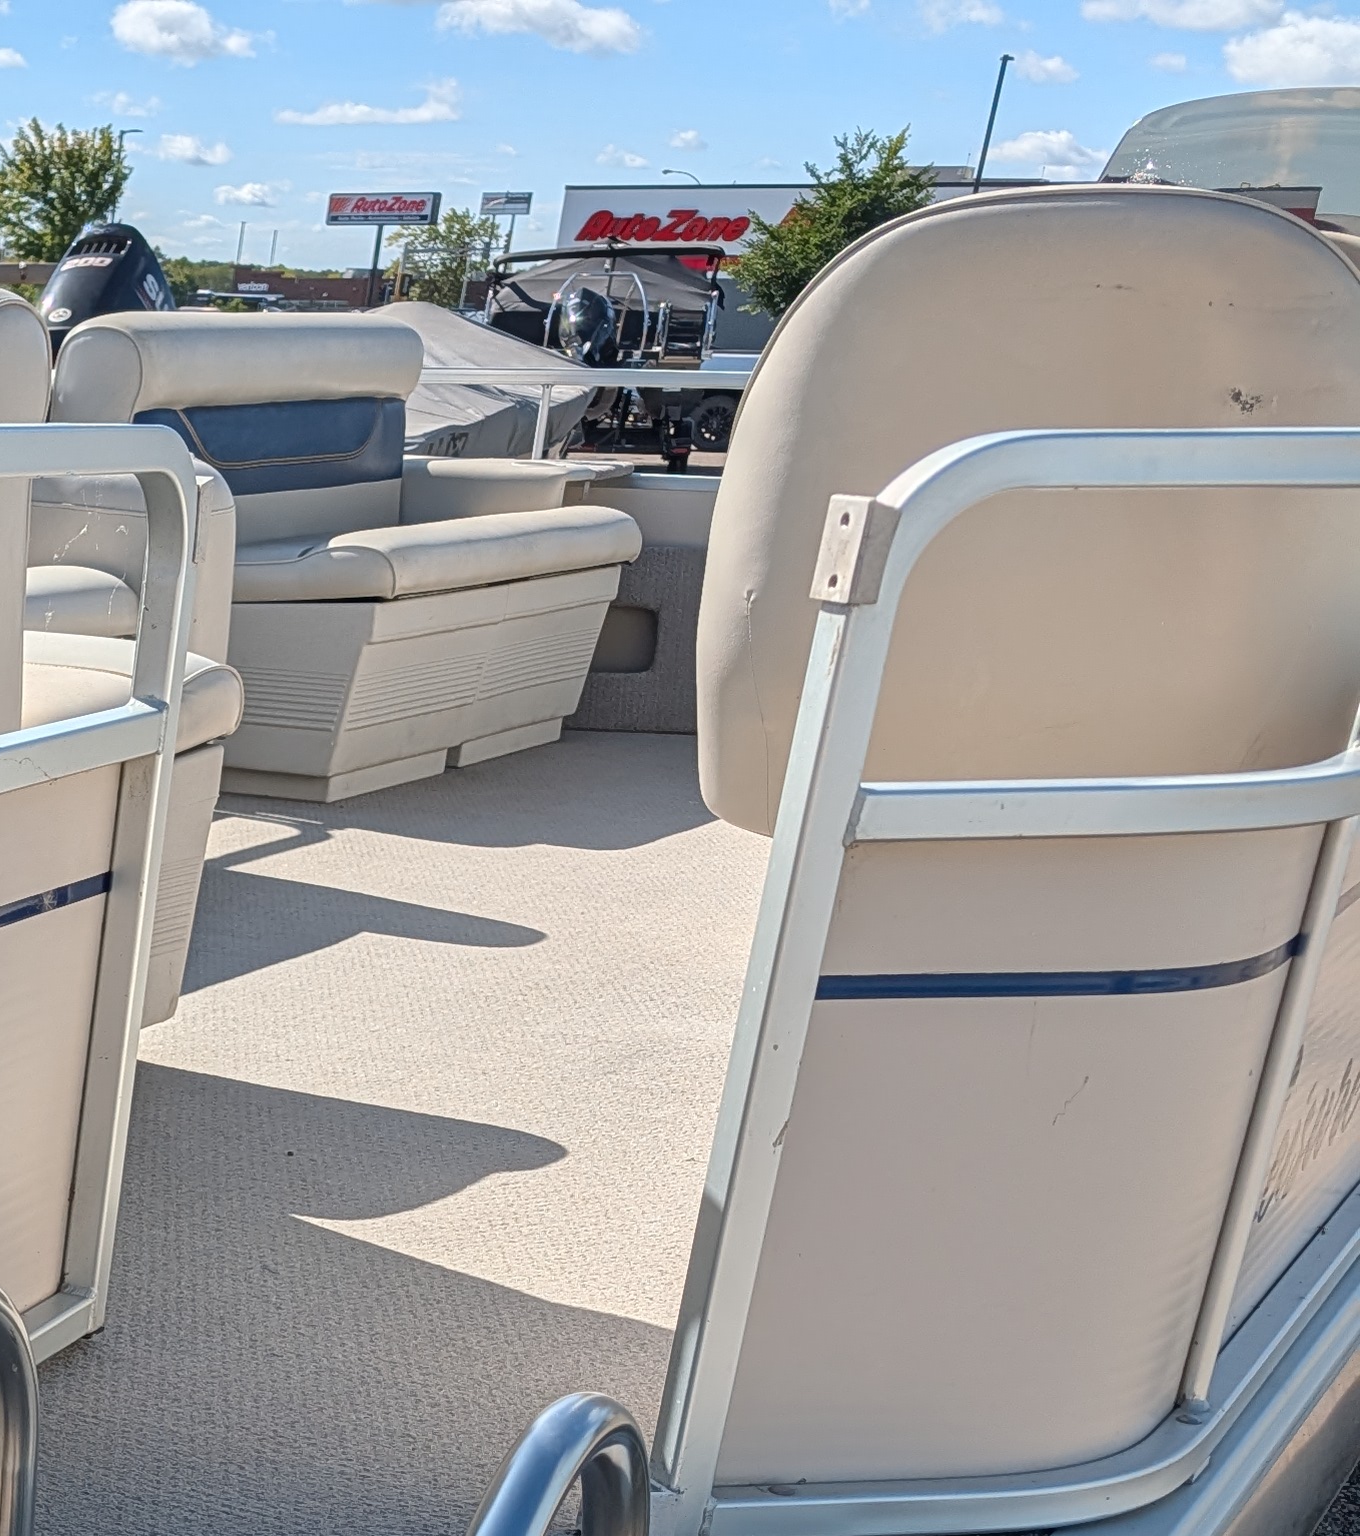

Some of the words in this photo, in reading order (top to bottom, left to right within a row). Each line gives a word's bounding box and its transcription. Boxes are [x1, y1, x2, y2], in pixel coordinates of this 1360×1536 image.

[351, 196, 427, 213] AutoZone
[574, 209, 750, 242] AutoZone
[60, 256, 113, 272] 200
